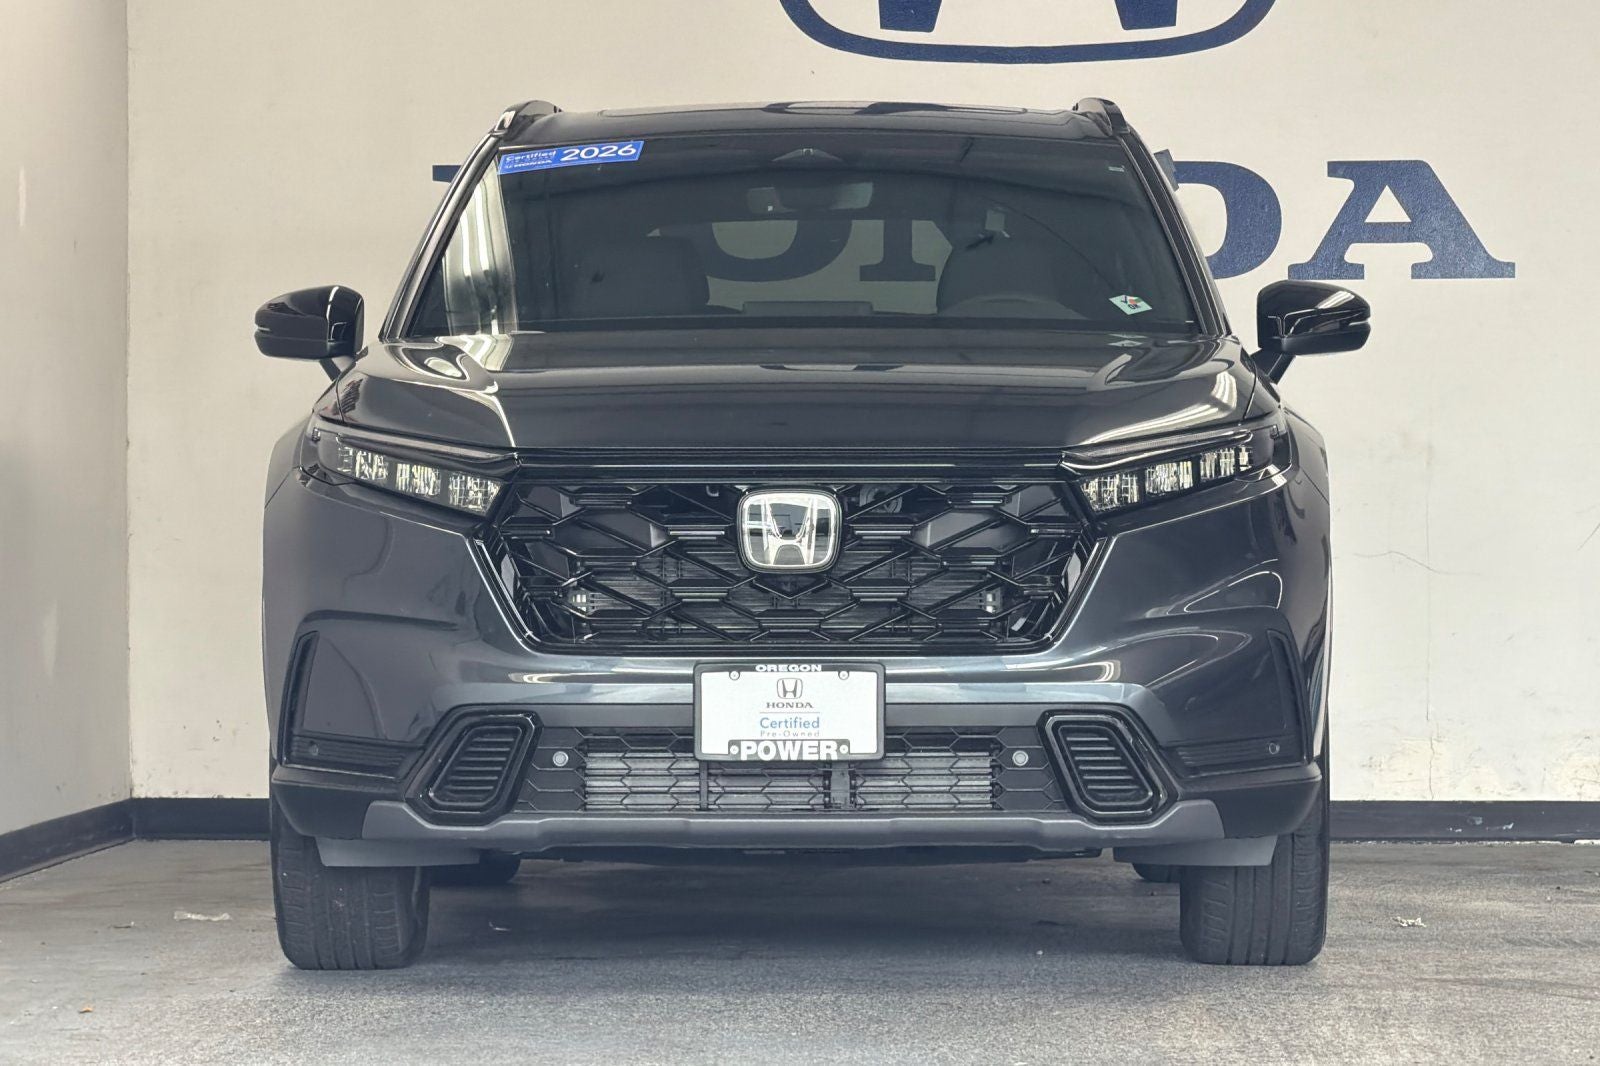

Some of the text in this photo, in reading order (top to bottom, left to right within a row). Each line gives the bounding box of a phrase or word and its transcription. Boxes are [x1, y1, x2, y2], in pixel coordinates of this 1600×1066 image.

[506, 150, 557, 161] Certified
[560, 144, 637, 161] 2026
[755, 664, 822, 672] OREGON
[760, 717, 820, 729] Certified
[740, 740, 838, 761] POWER
